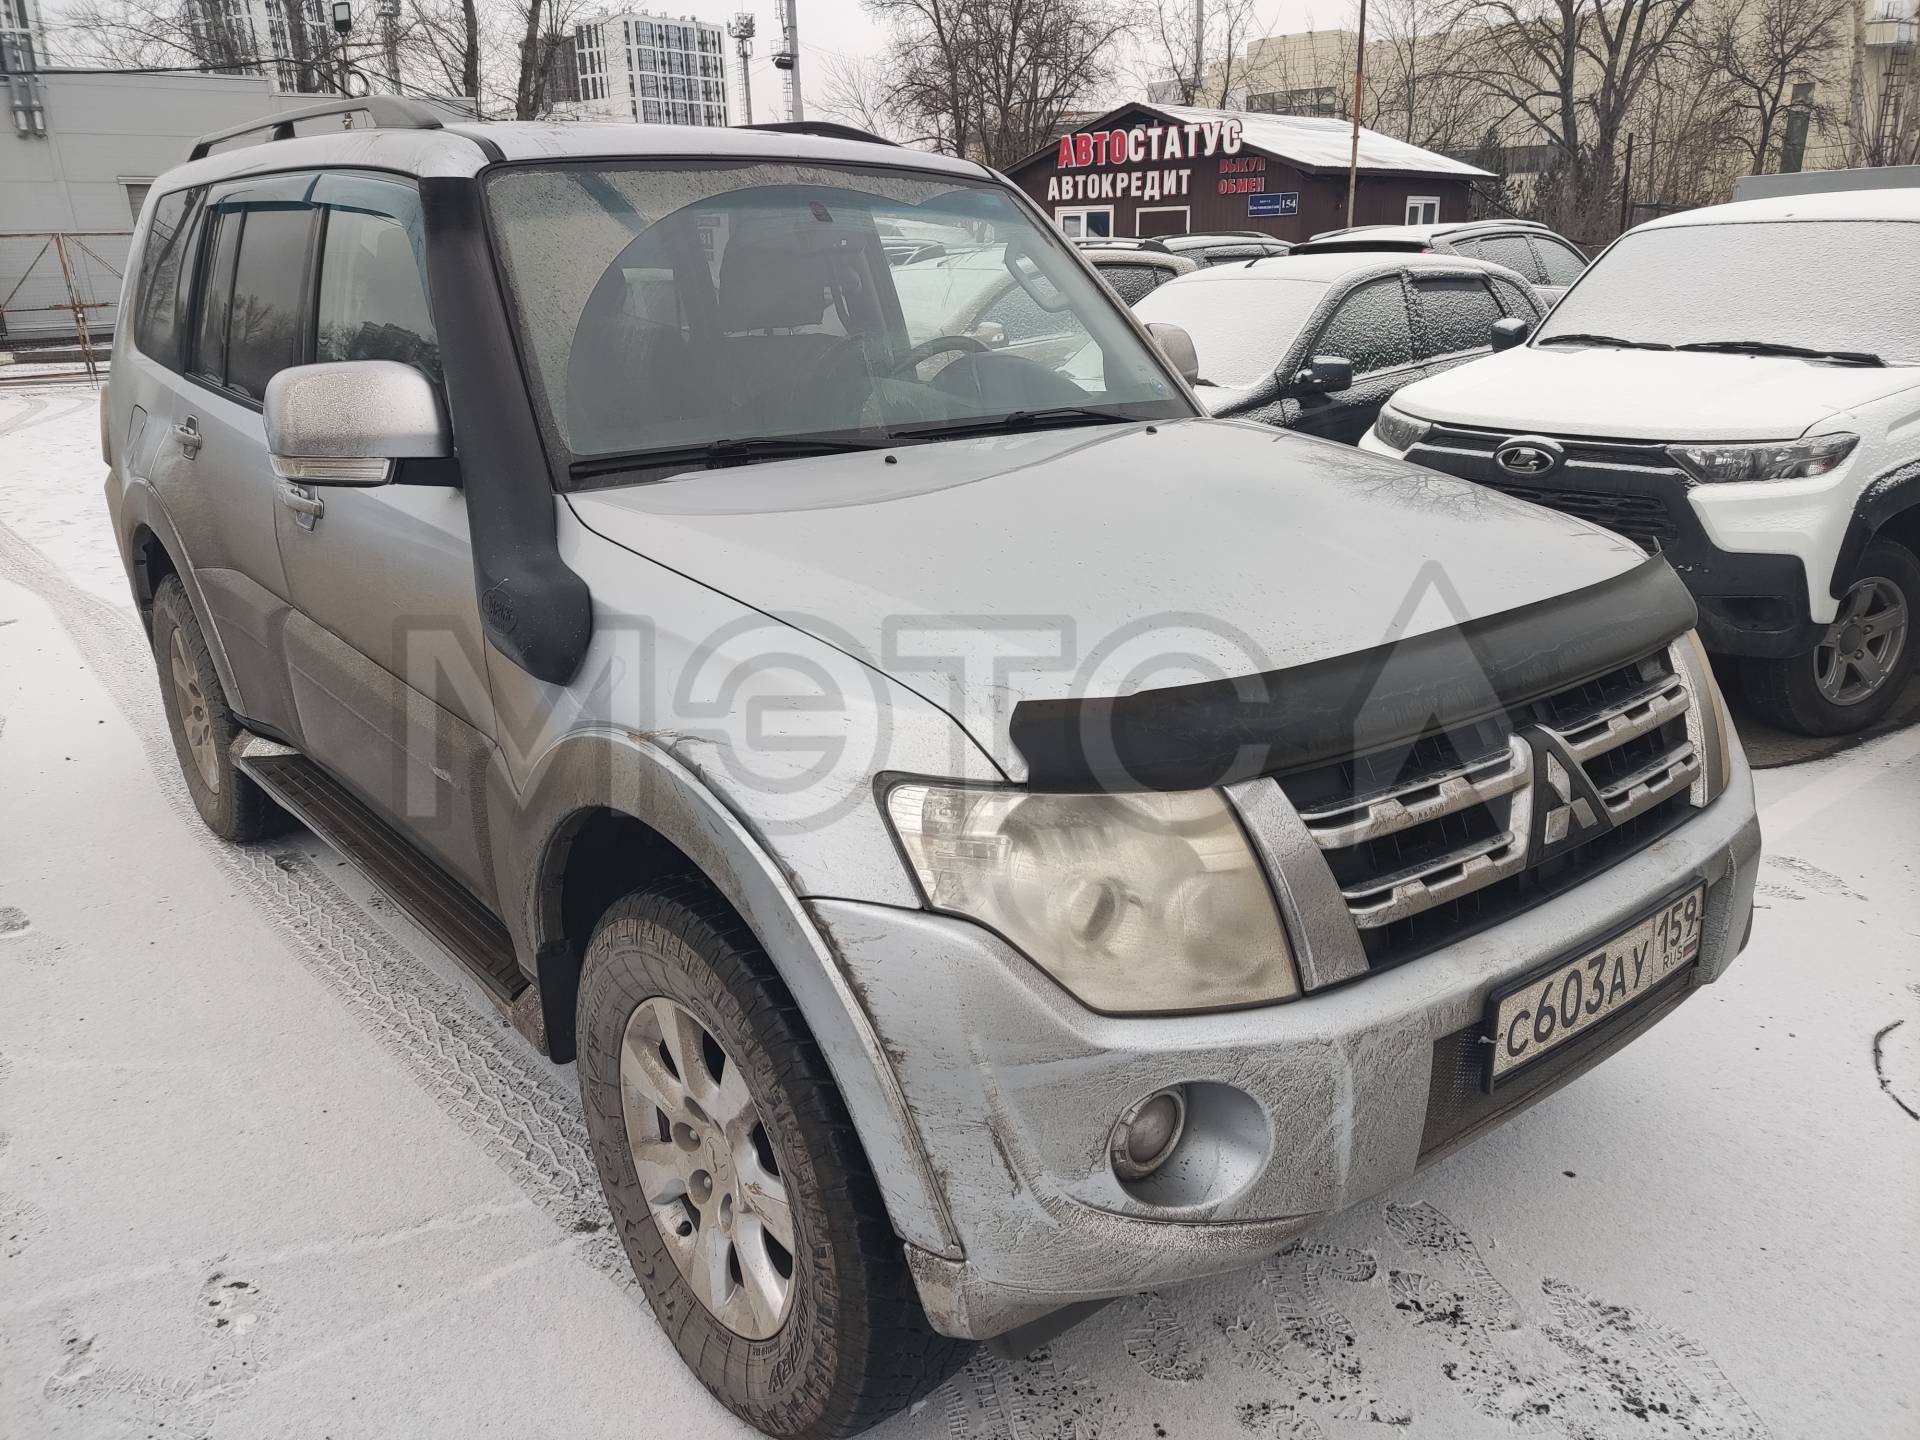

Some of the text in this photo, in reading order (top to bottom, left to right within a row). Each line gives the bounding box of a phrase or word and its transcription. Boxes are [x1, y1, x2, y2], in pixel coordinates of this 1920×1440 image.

[1057, 119, 1243, 169] АВТОСТАТУС
[1218, 156, 1265, 174] ВЫКУП
[1047, 168, 1192, 201] АВТОКРЕДИТ
[1217, 176, 1265, 195] ОБМЕН
[1281, 199, 1297, 209] 154
[1657, 895, 1698, 953] 159
[1662, 945, 1684, 971] RUS
